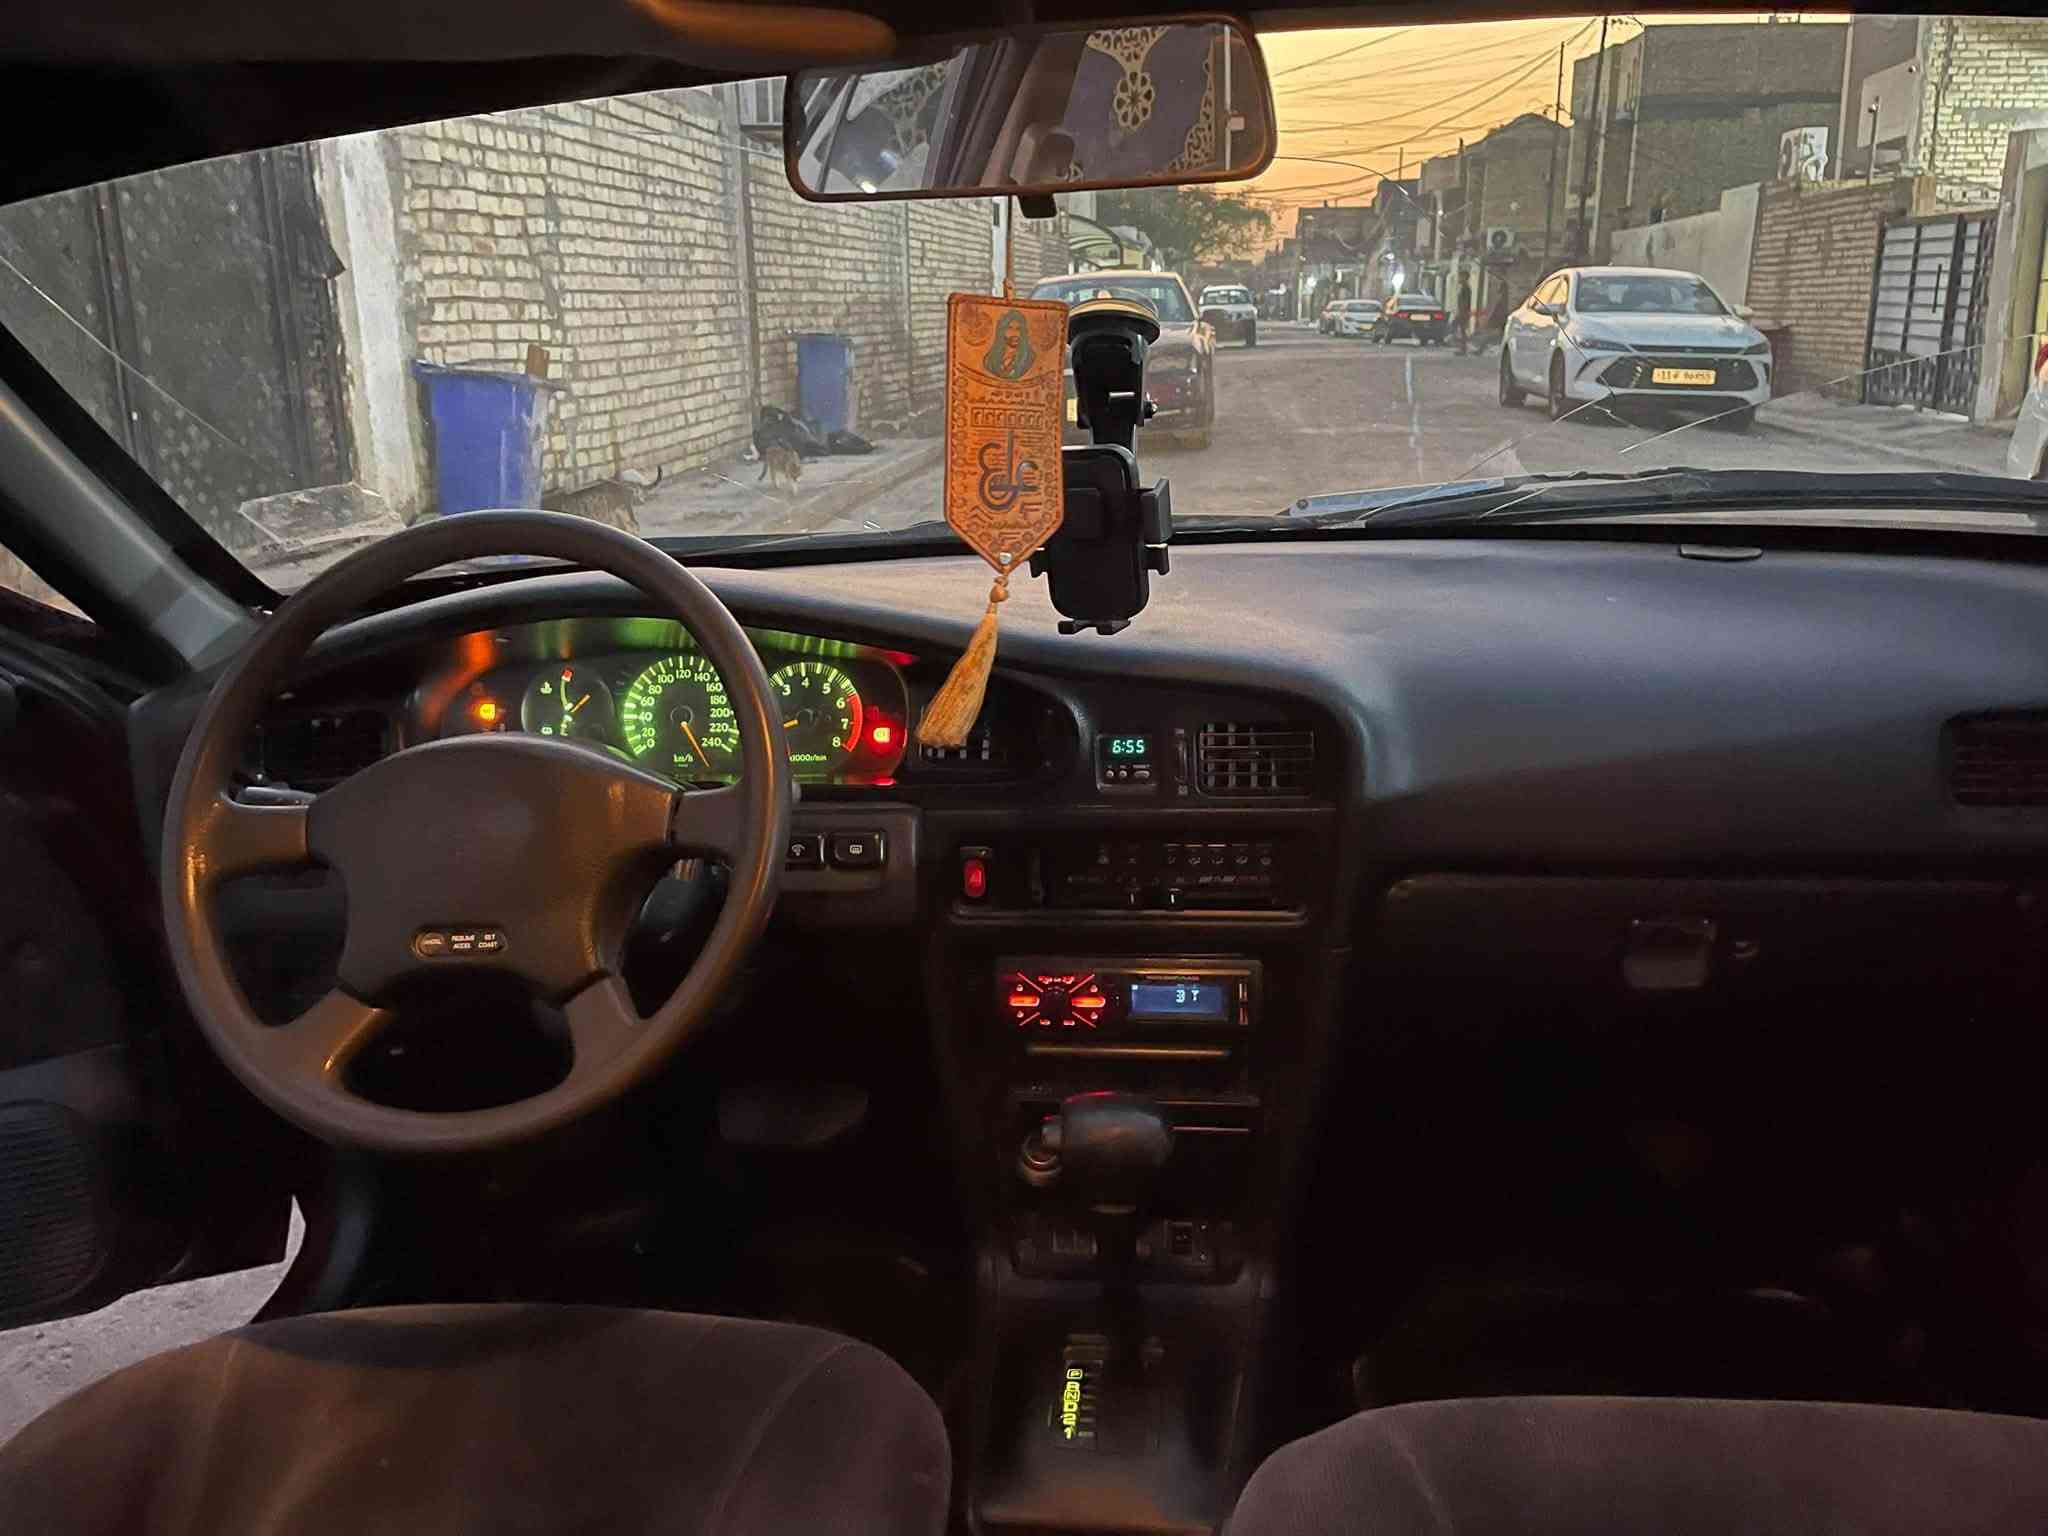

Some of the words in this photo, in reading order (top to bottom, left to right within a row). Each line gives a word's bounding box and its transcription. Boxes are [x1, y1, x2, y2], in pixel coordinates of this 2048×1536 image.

[657, 674, 674, 684] 100
[676, 669, 692, 679] 120
[694, 672, 711, 682] 140
[706, 683, 724, 692] 160
[801, 677, 810, 688] 4
[648, 685, 662, 695] 80
[782, 684, 791, 696] 3
[822, 682, 832, 695] 5
[640, 696, 655, 706] 60
[710, 695, 727, 705] 180
[836, 697, 846, 709] 6
[639, 711, 653, 721] 40
[709, 708, 730, 718] 200
[709, 723, 729, 733] 220
[840, 718, 849, 730] 7
[641, 728, 656, 738] 20
[646, 739, 655, 748] 0
[701, 737, 722, 747] 240
[832, 736, 841, 748] 8
[1112, 738, 1145, 754] 6:55
[1063, 1427, 1073, 1440] 1
